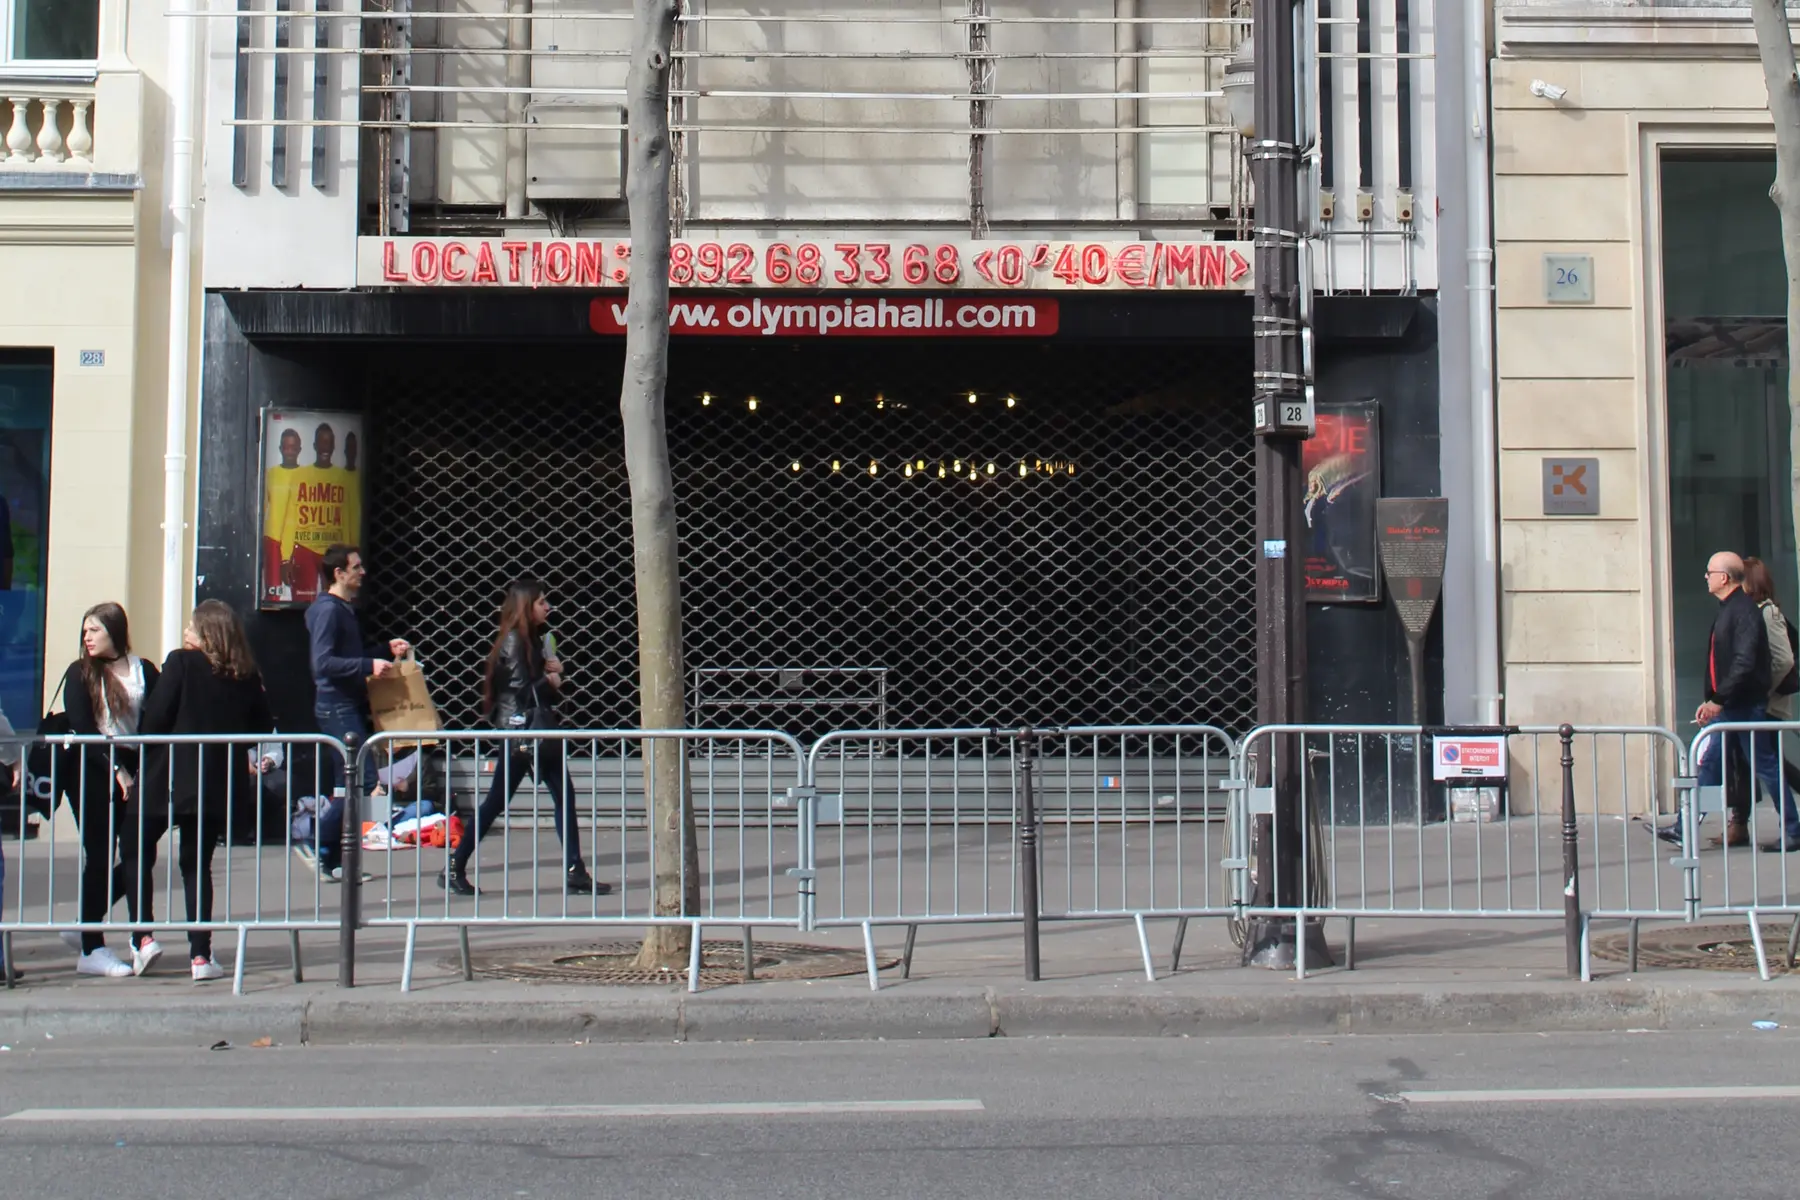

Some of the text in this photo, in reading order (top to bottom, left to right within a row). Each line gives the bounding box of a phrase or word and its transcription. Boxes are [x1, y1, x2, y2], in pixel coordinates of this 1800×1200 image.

[765, 243, 821, 283] 68
[834, 243, 891, 284] 33
[903, 243, 959, 284] 68
[1556, 267, 1578, 285] 26
[611, 298, 1036, 335] w.olympiahall.com
[82, 352, 101, 365] 28
[1286, 407, 1302, 422] 28
[297, 482, 344, 503] AHMED
[298, 504, 342, 526] SYLLA
[295, 531, 311, 541] AVEC
